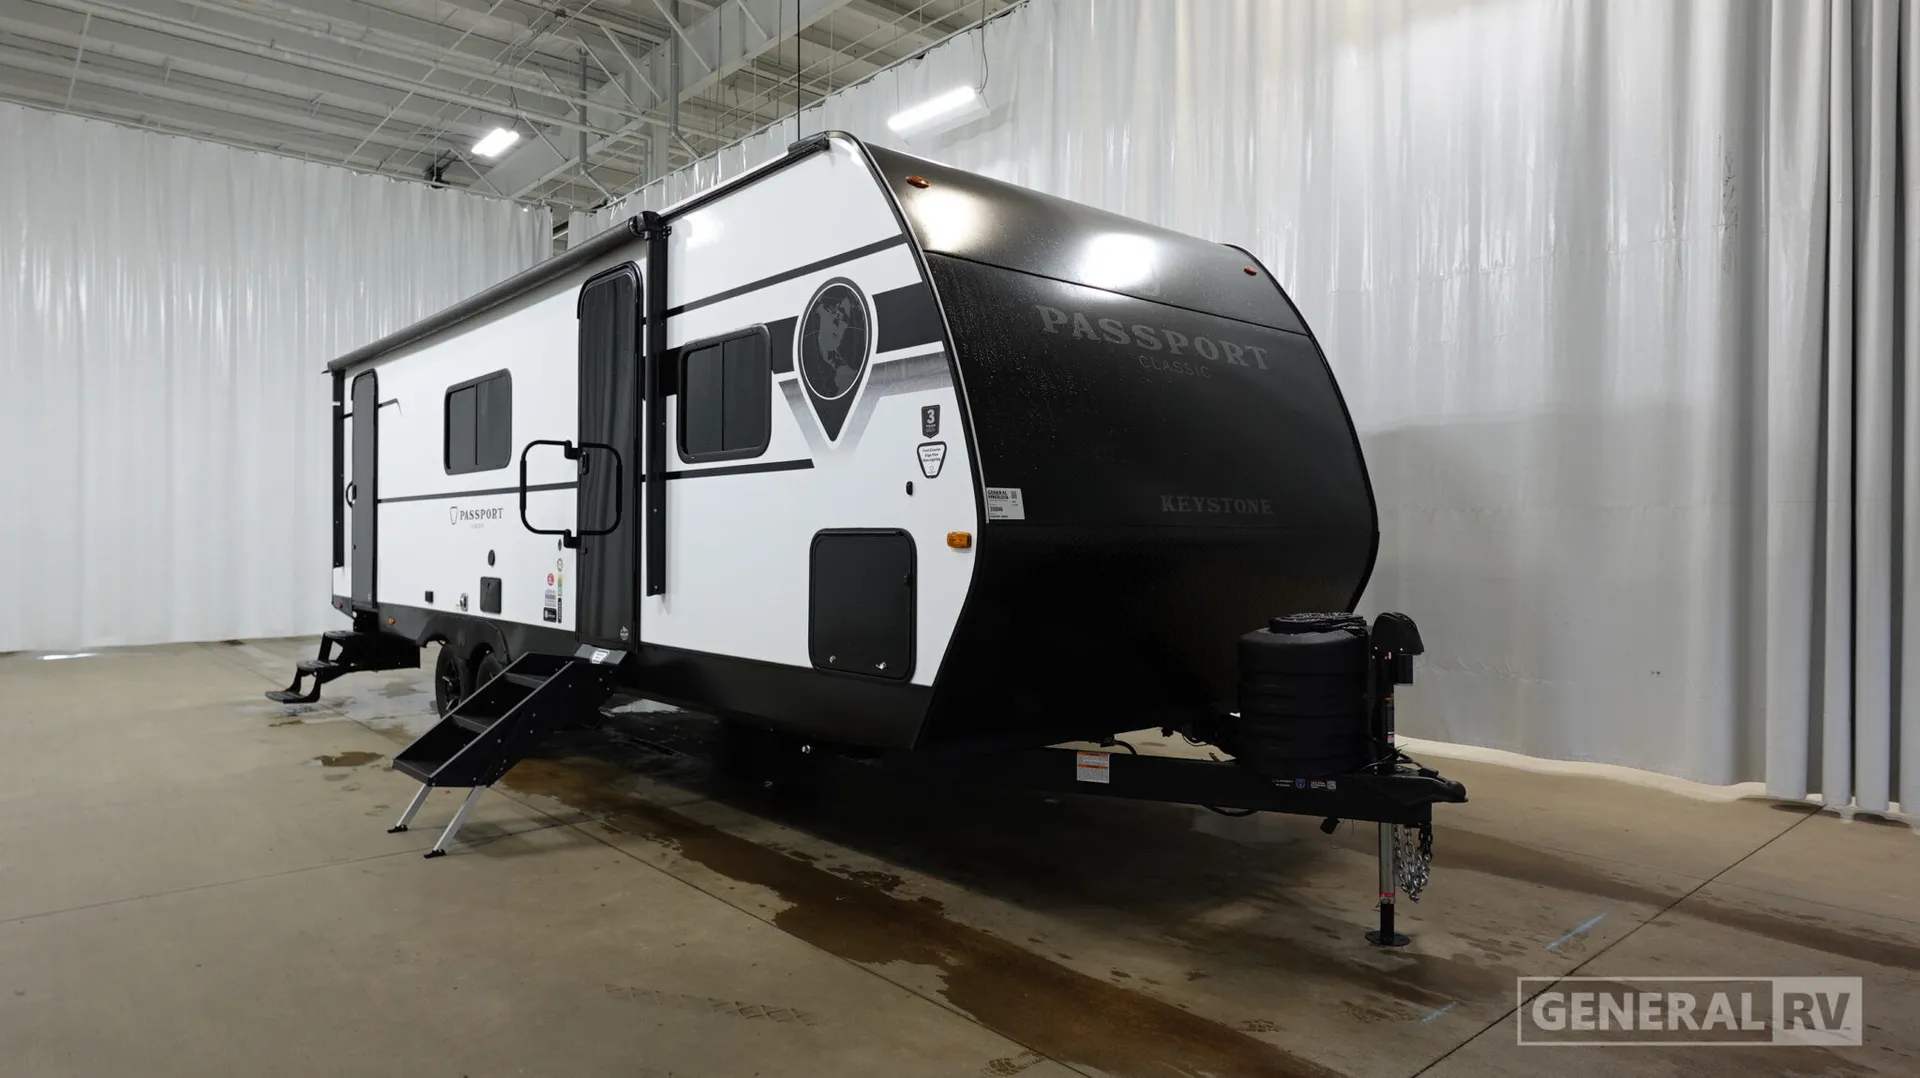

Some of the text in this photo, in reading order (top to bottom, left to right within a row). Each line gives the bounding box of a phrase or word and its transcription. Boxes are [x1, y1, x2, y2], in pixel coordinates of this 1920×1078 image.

[1036, 304, 1269, 370] PASSPORT
[1139, 354, 1212, 379] CLASSIC
[926, 409, 935, 423] 3
[460, 507, 504, 521] PASSPORT
[1159, 495, 1274, 515] KEYSTONE
